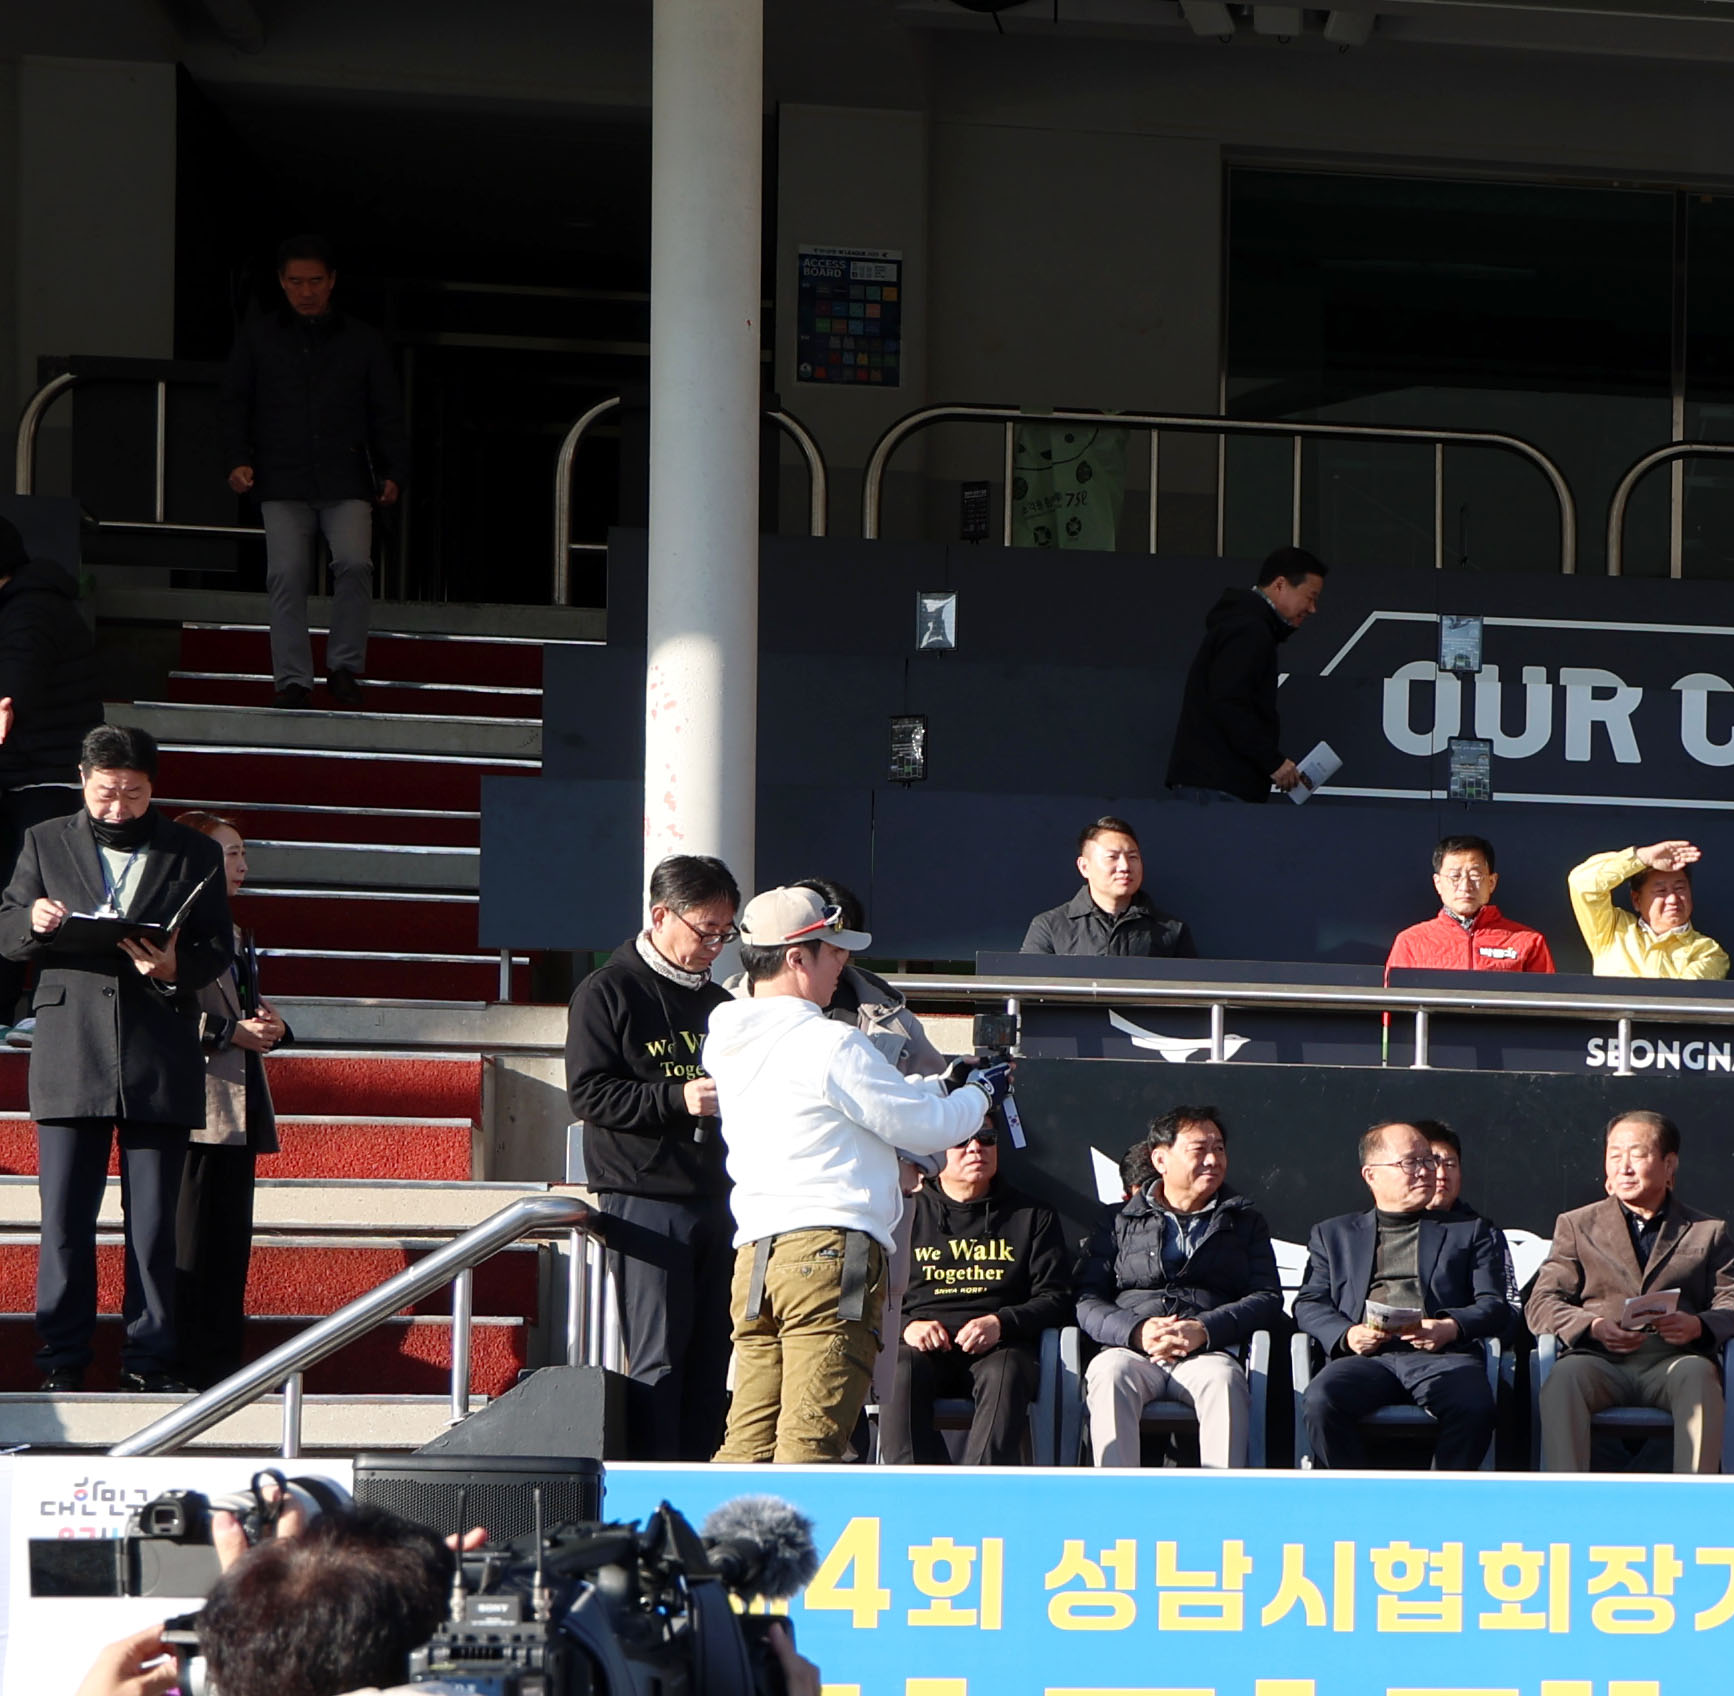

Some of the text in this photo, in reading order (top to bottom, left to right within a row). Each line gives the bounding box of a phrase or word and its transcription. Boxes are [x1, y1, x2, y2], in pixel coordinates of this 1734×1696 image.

[802, 258, 847, 270] ACCESS
[802, 267, 842, 278] BOARD
[1382, 660, 1643, 764] OUR
[660, 1061, 706, 1080] Toge
[914, 1238, 1015, 1262] We Walk
[922, 1264, 1005, 1285] Together
